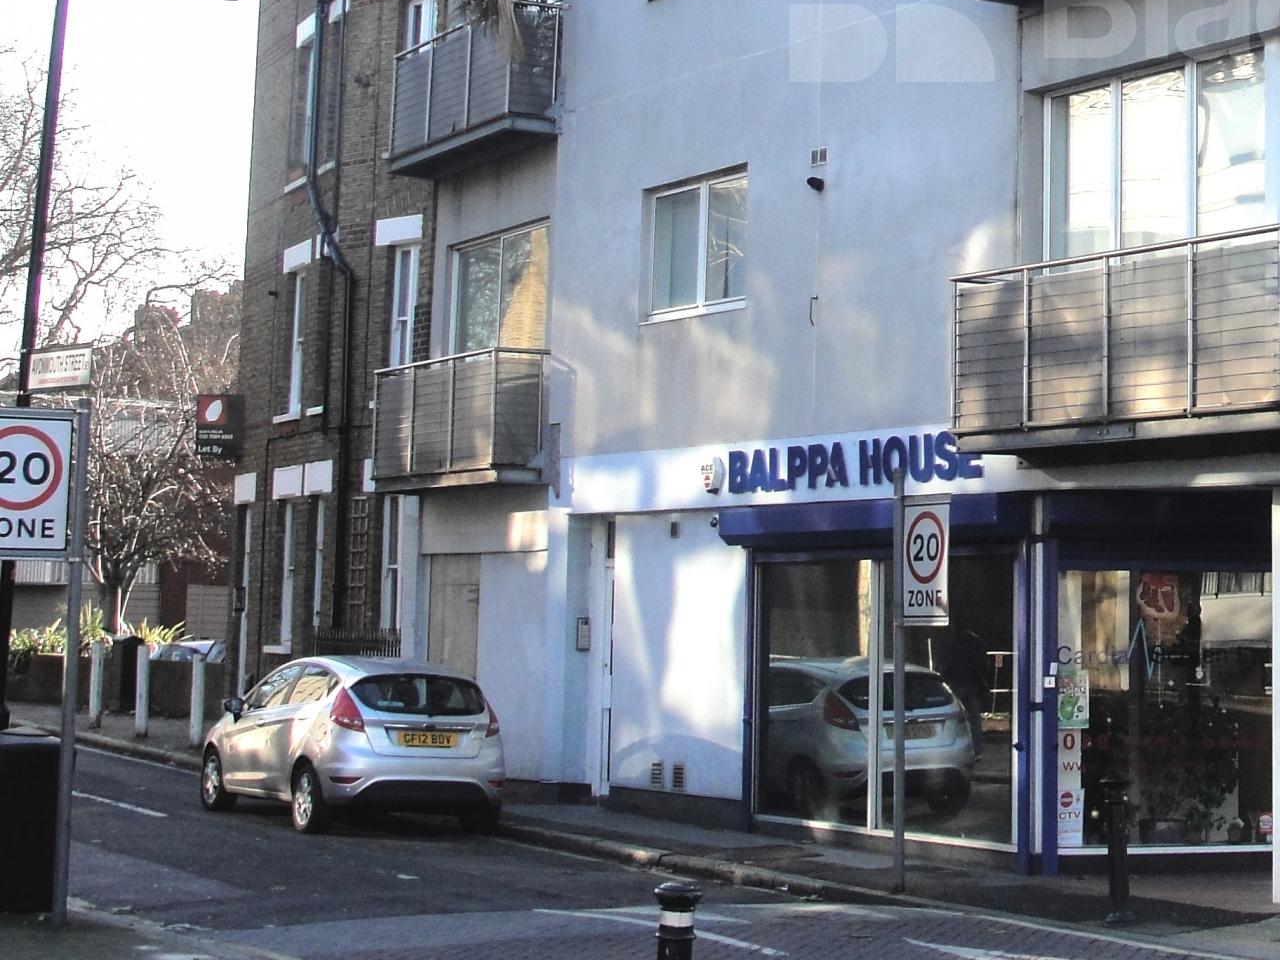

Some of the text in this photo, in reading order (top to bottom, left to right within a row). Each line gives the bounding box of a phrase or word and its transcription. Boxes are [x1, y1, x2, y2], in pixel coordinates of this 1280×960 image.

[0, 451, 50, 485] 20
[728, 430, 984, 494] BALPPA HOUSE
[0, 517, 55, 539] ONE
[913, 533, 940, 563] 20
[908, 589, 943, 608] ZONE
[1058, 811, 1082, 820] CTV
